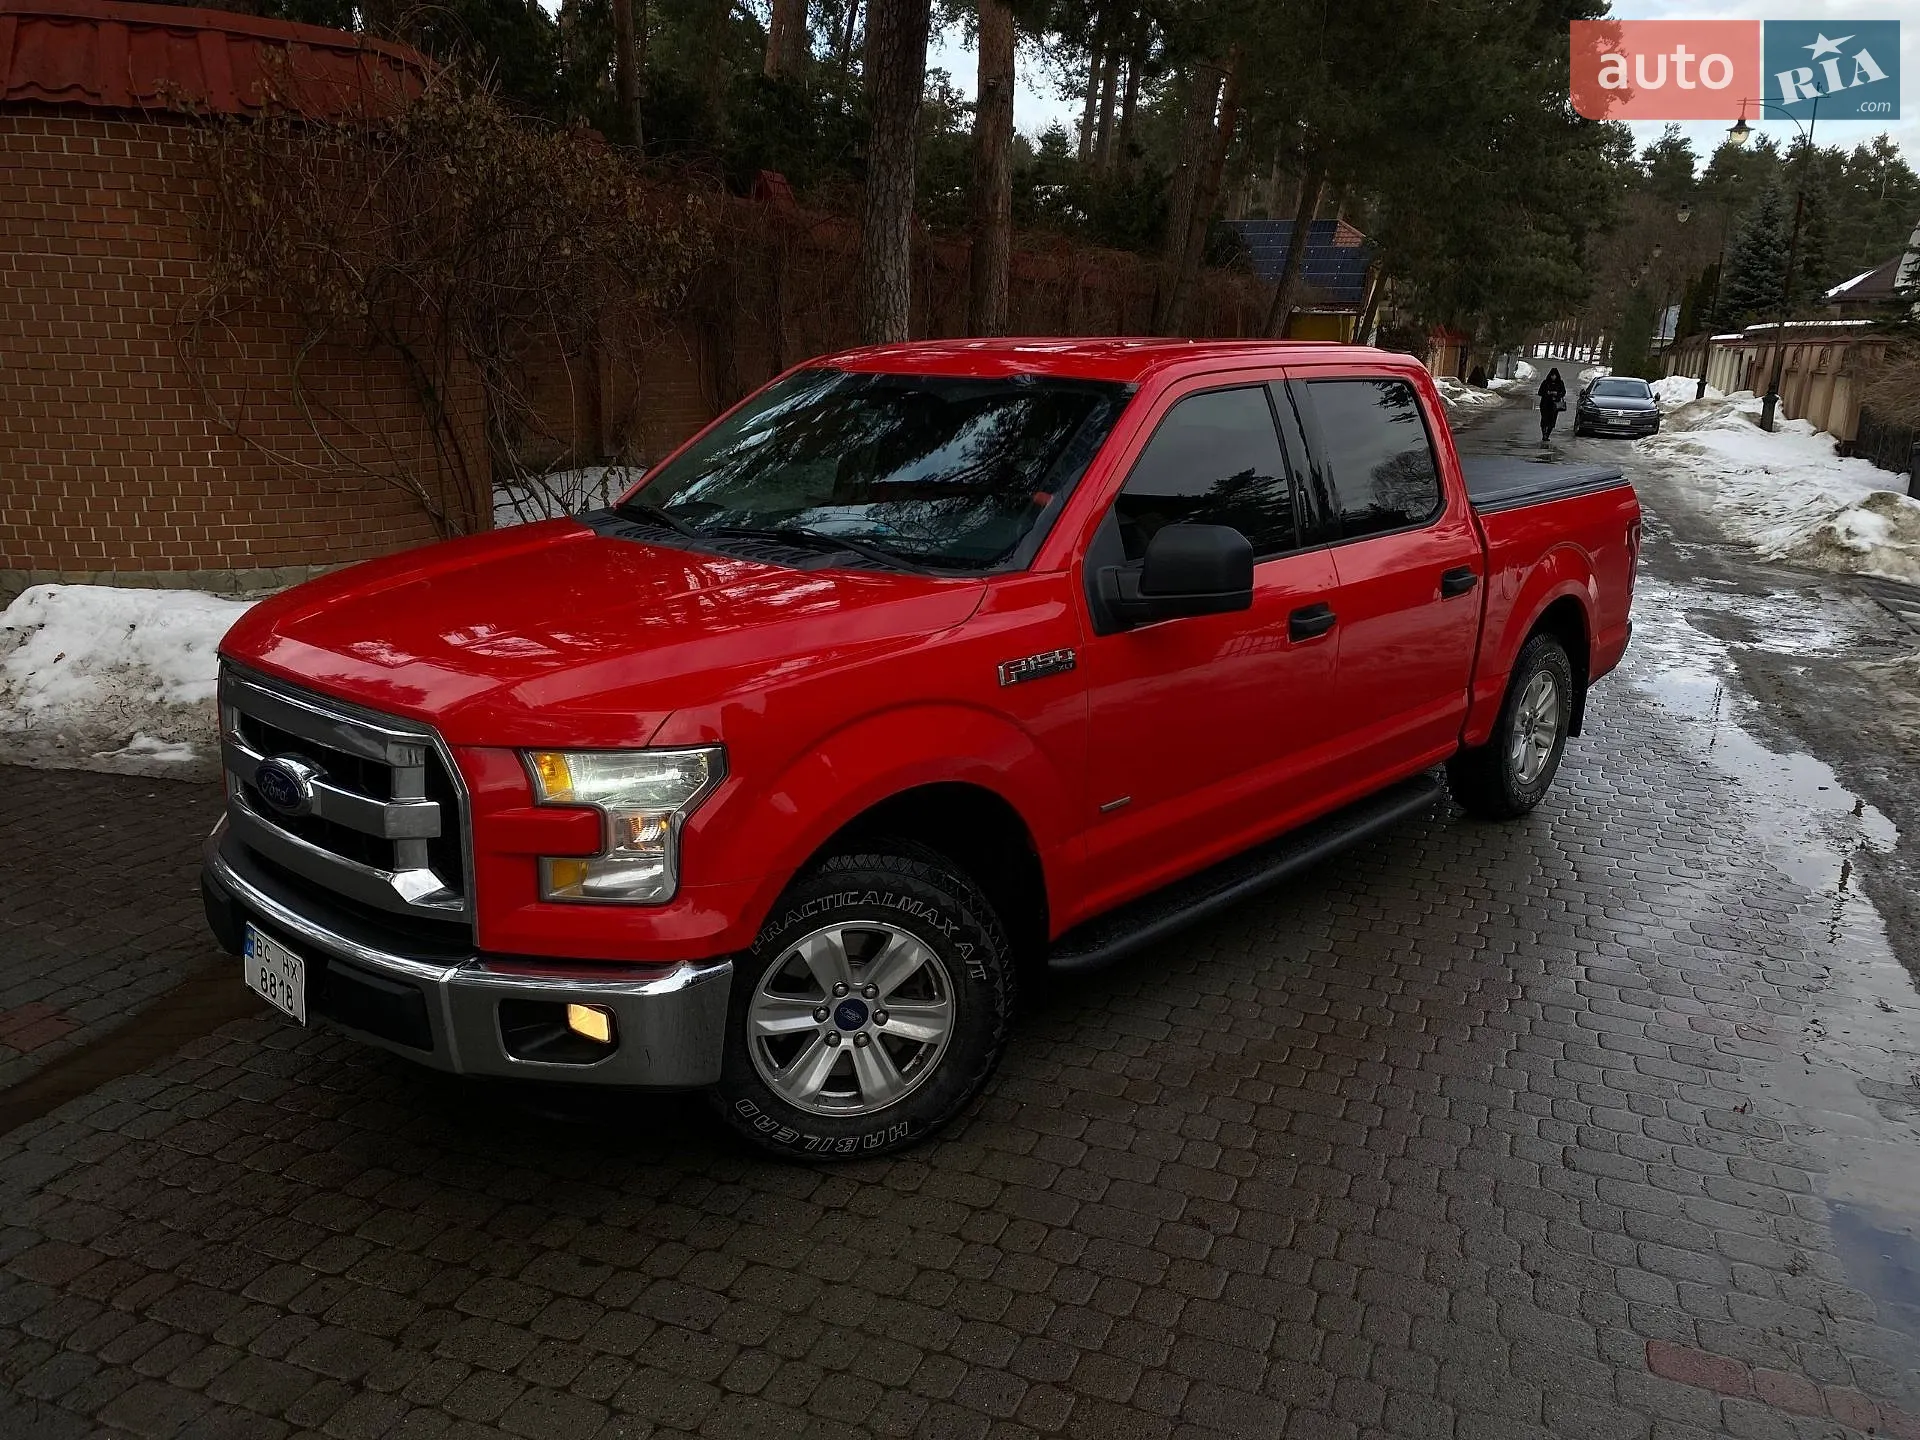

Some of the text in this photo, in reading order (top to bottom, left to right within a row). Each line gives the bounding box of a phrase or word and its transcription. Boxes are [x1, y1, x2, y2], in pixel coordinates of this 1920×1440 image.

[1058, 662, 1074, 672] XLT
[261, 770, 290, 803] Ford
[750, 890, 988, 981] PRACTICALMAX A/T
[256, 937, 271, 963] BC
[282, 954, 299, 983] HX
[261, 966, 294, 1011] 8818
[735, 1098, 909, 1153] HABILEAD
